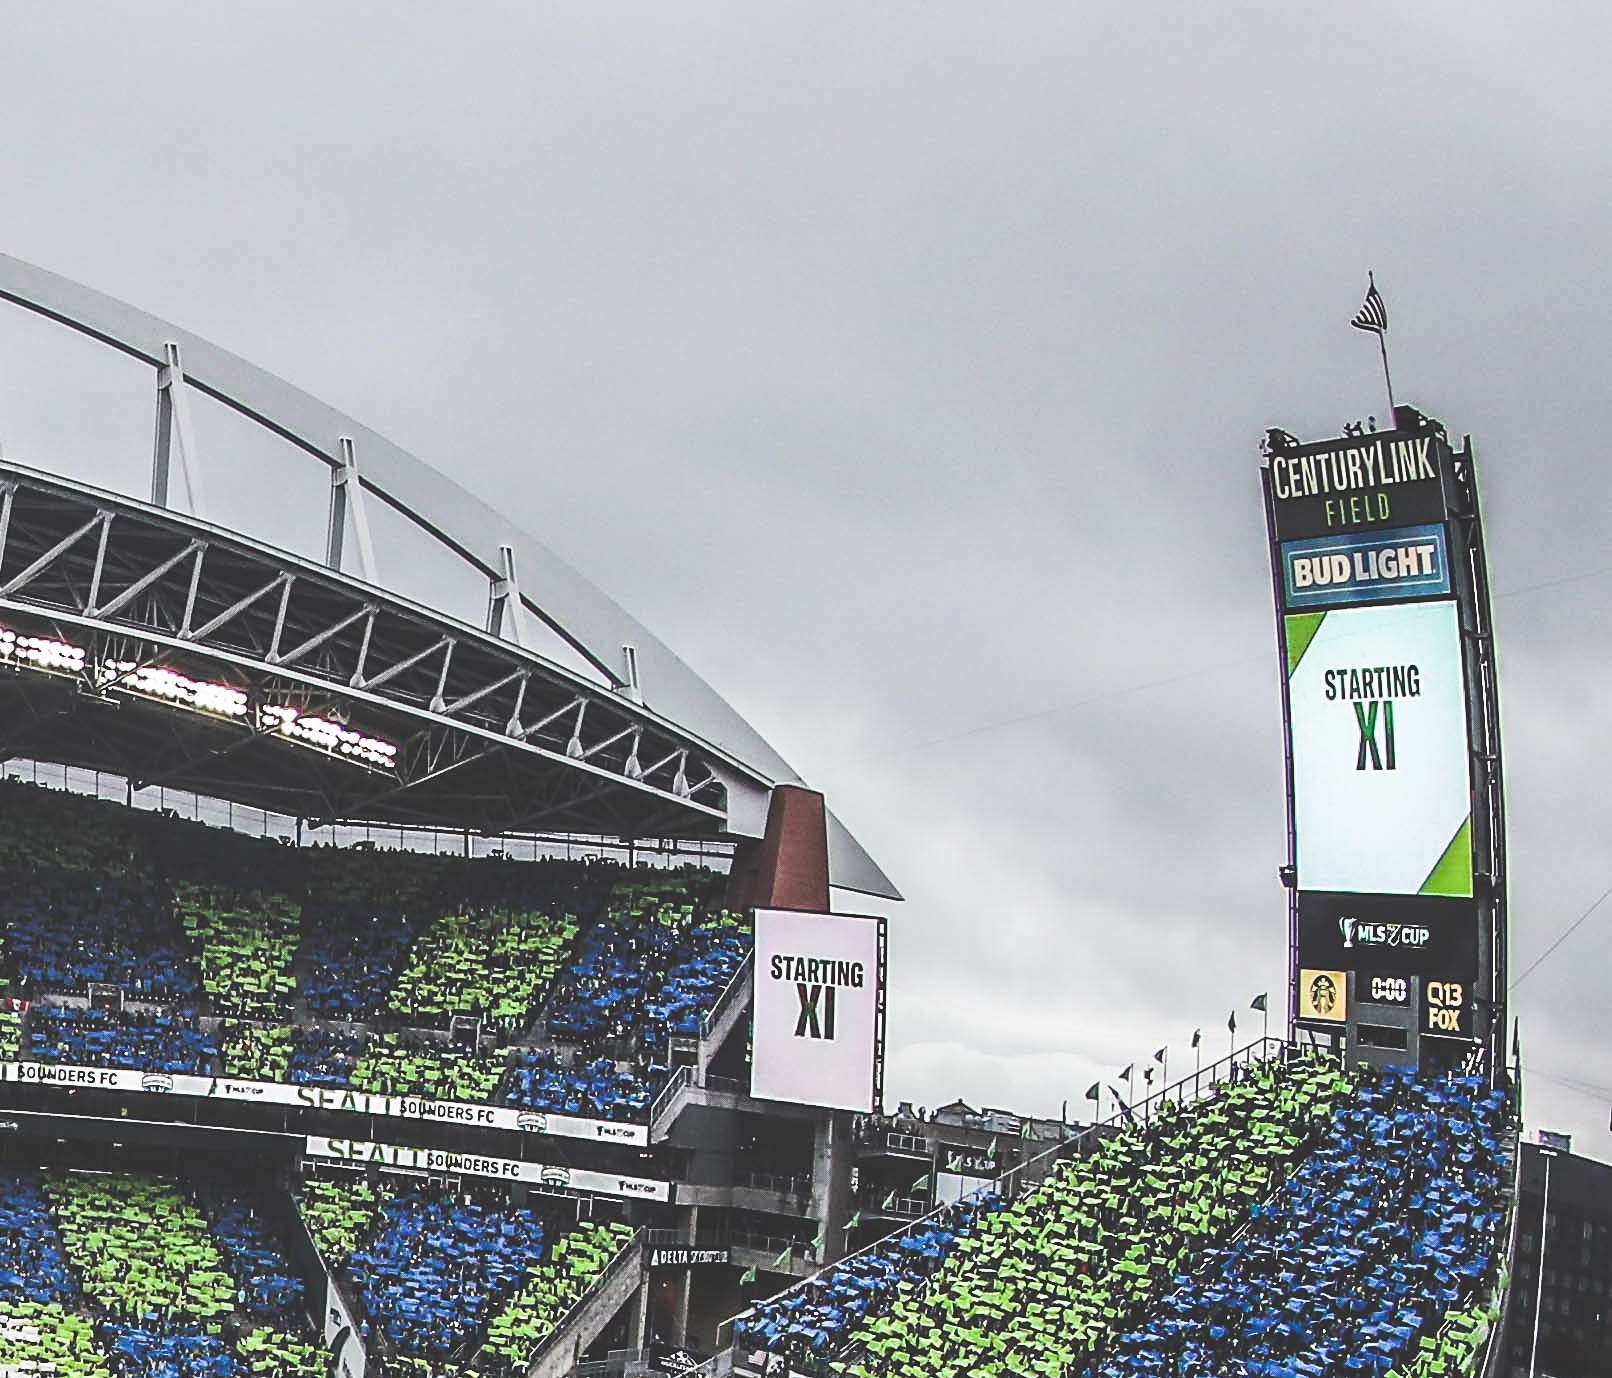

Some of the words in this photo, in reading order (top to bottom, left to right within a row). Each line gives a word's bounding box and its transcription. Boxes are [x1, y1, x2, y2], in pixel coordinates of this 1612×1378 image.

[1273, 437, 1436, 500] CENTURYLINK
[1326, 493, 1390, 526] FIELD
[1293, 554, 1351, 588] BUD
[1353, 545, 1437, 581] LIGHT
[1325, 664, 1421, 700] STARTING
[1353, 700, 1396, 770] XI
[1358, 924, 1386, 943] MLS
[1402, 927, 1430, 945] CUP
[771, 954, 864, 988] STARTING
[1372, 977, 1407, 1002] 0:00
[1427, 981, 1463, 1008] Q13
[794, 983, 837, 1041] XI
[1428, 1007, 1461, 1032] FOX
[17, 1064, 96, 1085] SOUNDERS
[99, 1071, 118, 1086] FC
[400, 1099, 474, 1122] SOUNDERS
[477, 1105, 495, 1124] FC
[427, 1152, 499, 1176] SOUNDERS
[502, 1159, 520, 1177] FC
[660, 1250, 688, 1265] DELTA
